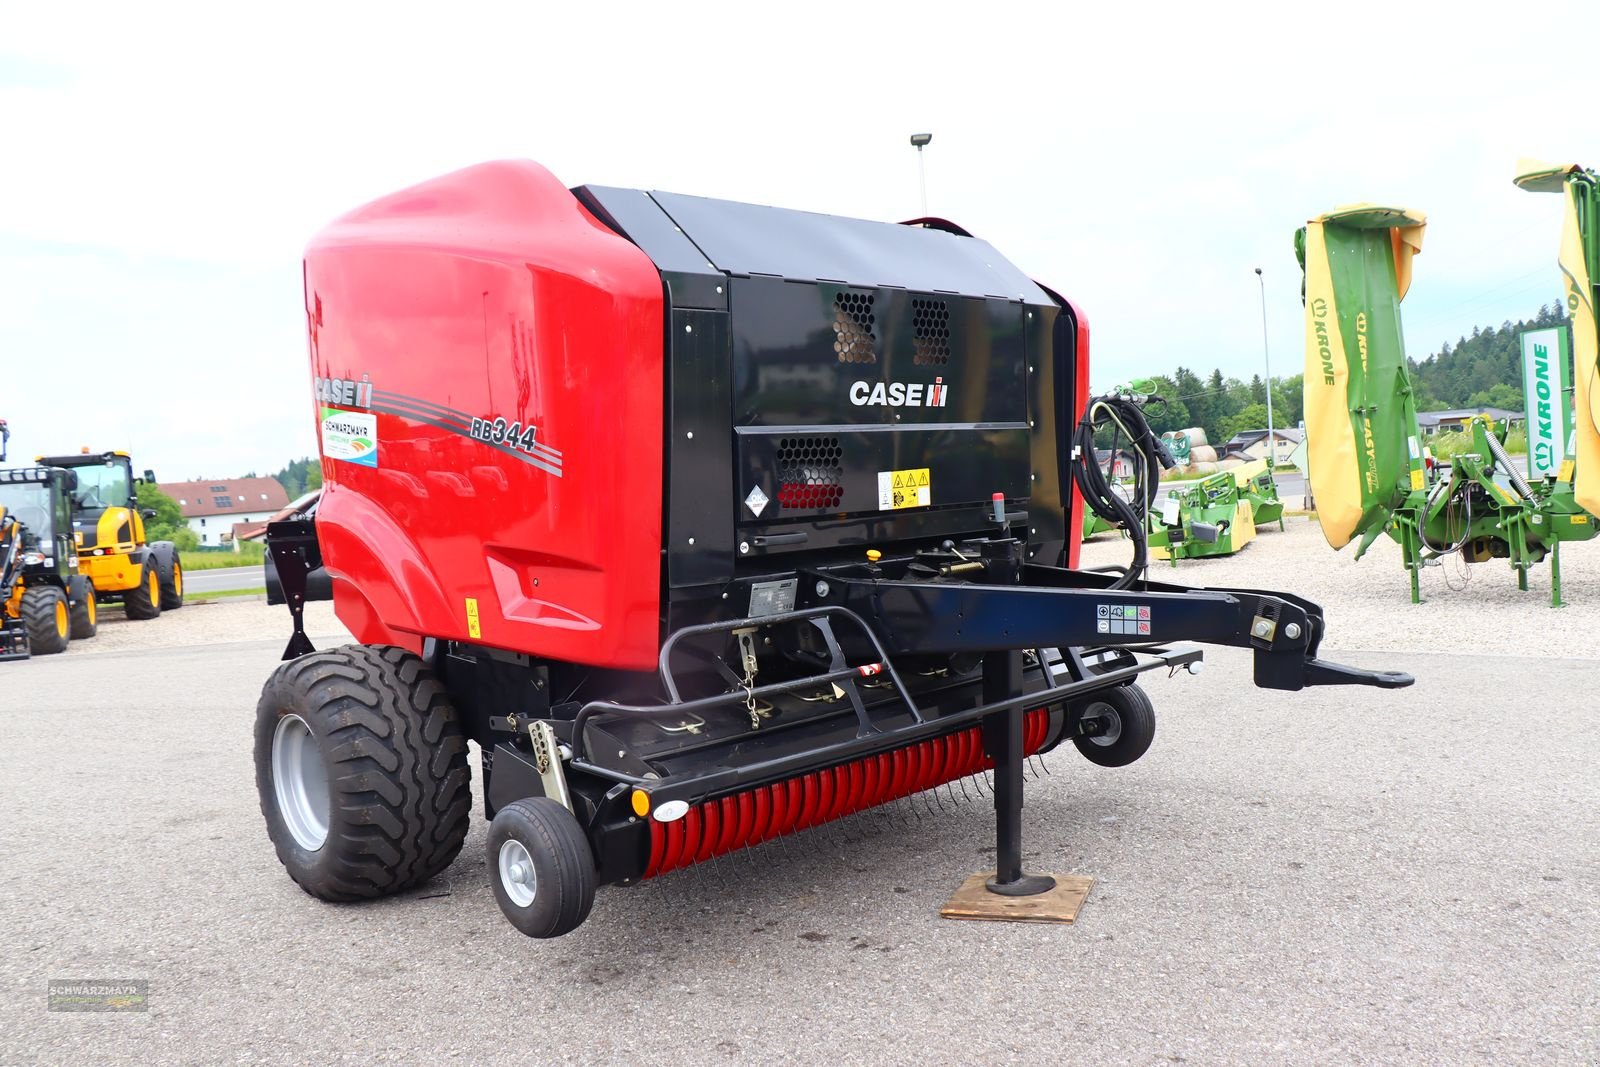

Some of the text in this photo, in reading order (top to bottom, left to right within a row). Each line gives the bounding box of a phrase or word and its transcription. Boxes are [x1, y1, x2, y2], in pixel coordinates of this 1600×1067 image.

[1314, 320, 1335, 386] KRONE
[314, 376, 354, 405] CASE
[849, 380, 924, 407] CASE
[1534, 343, 1552, 440] KRONE
[325, 420, 368, 437] SCHWARZMAYR
[470, 416, 537, 453] RB344
